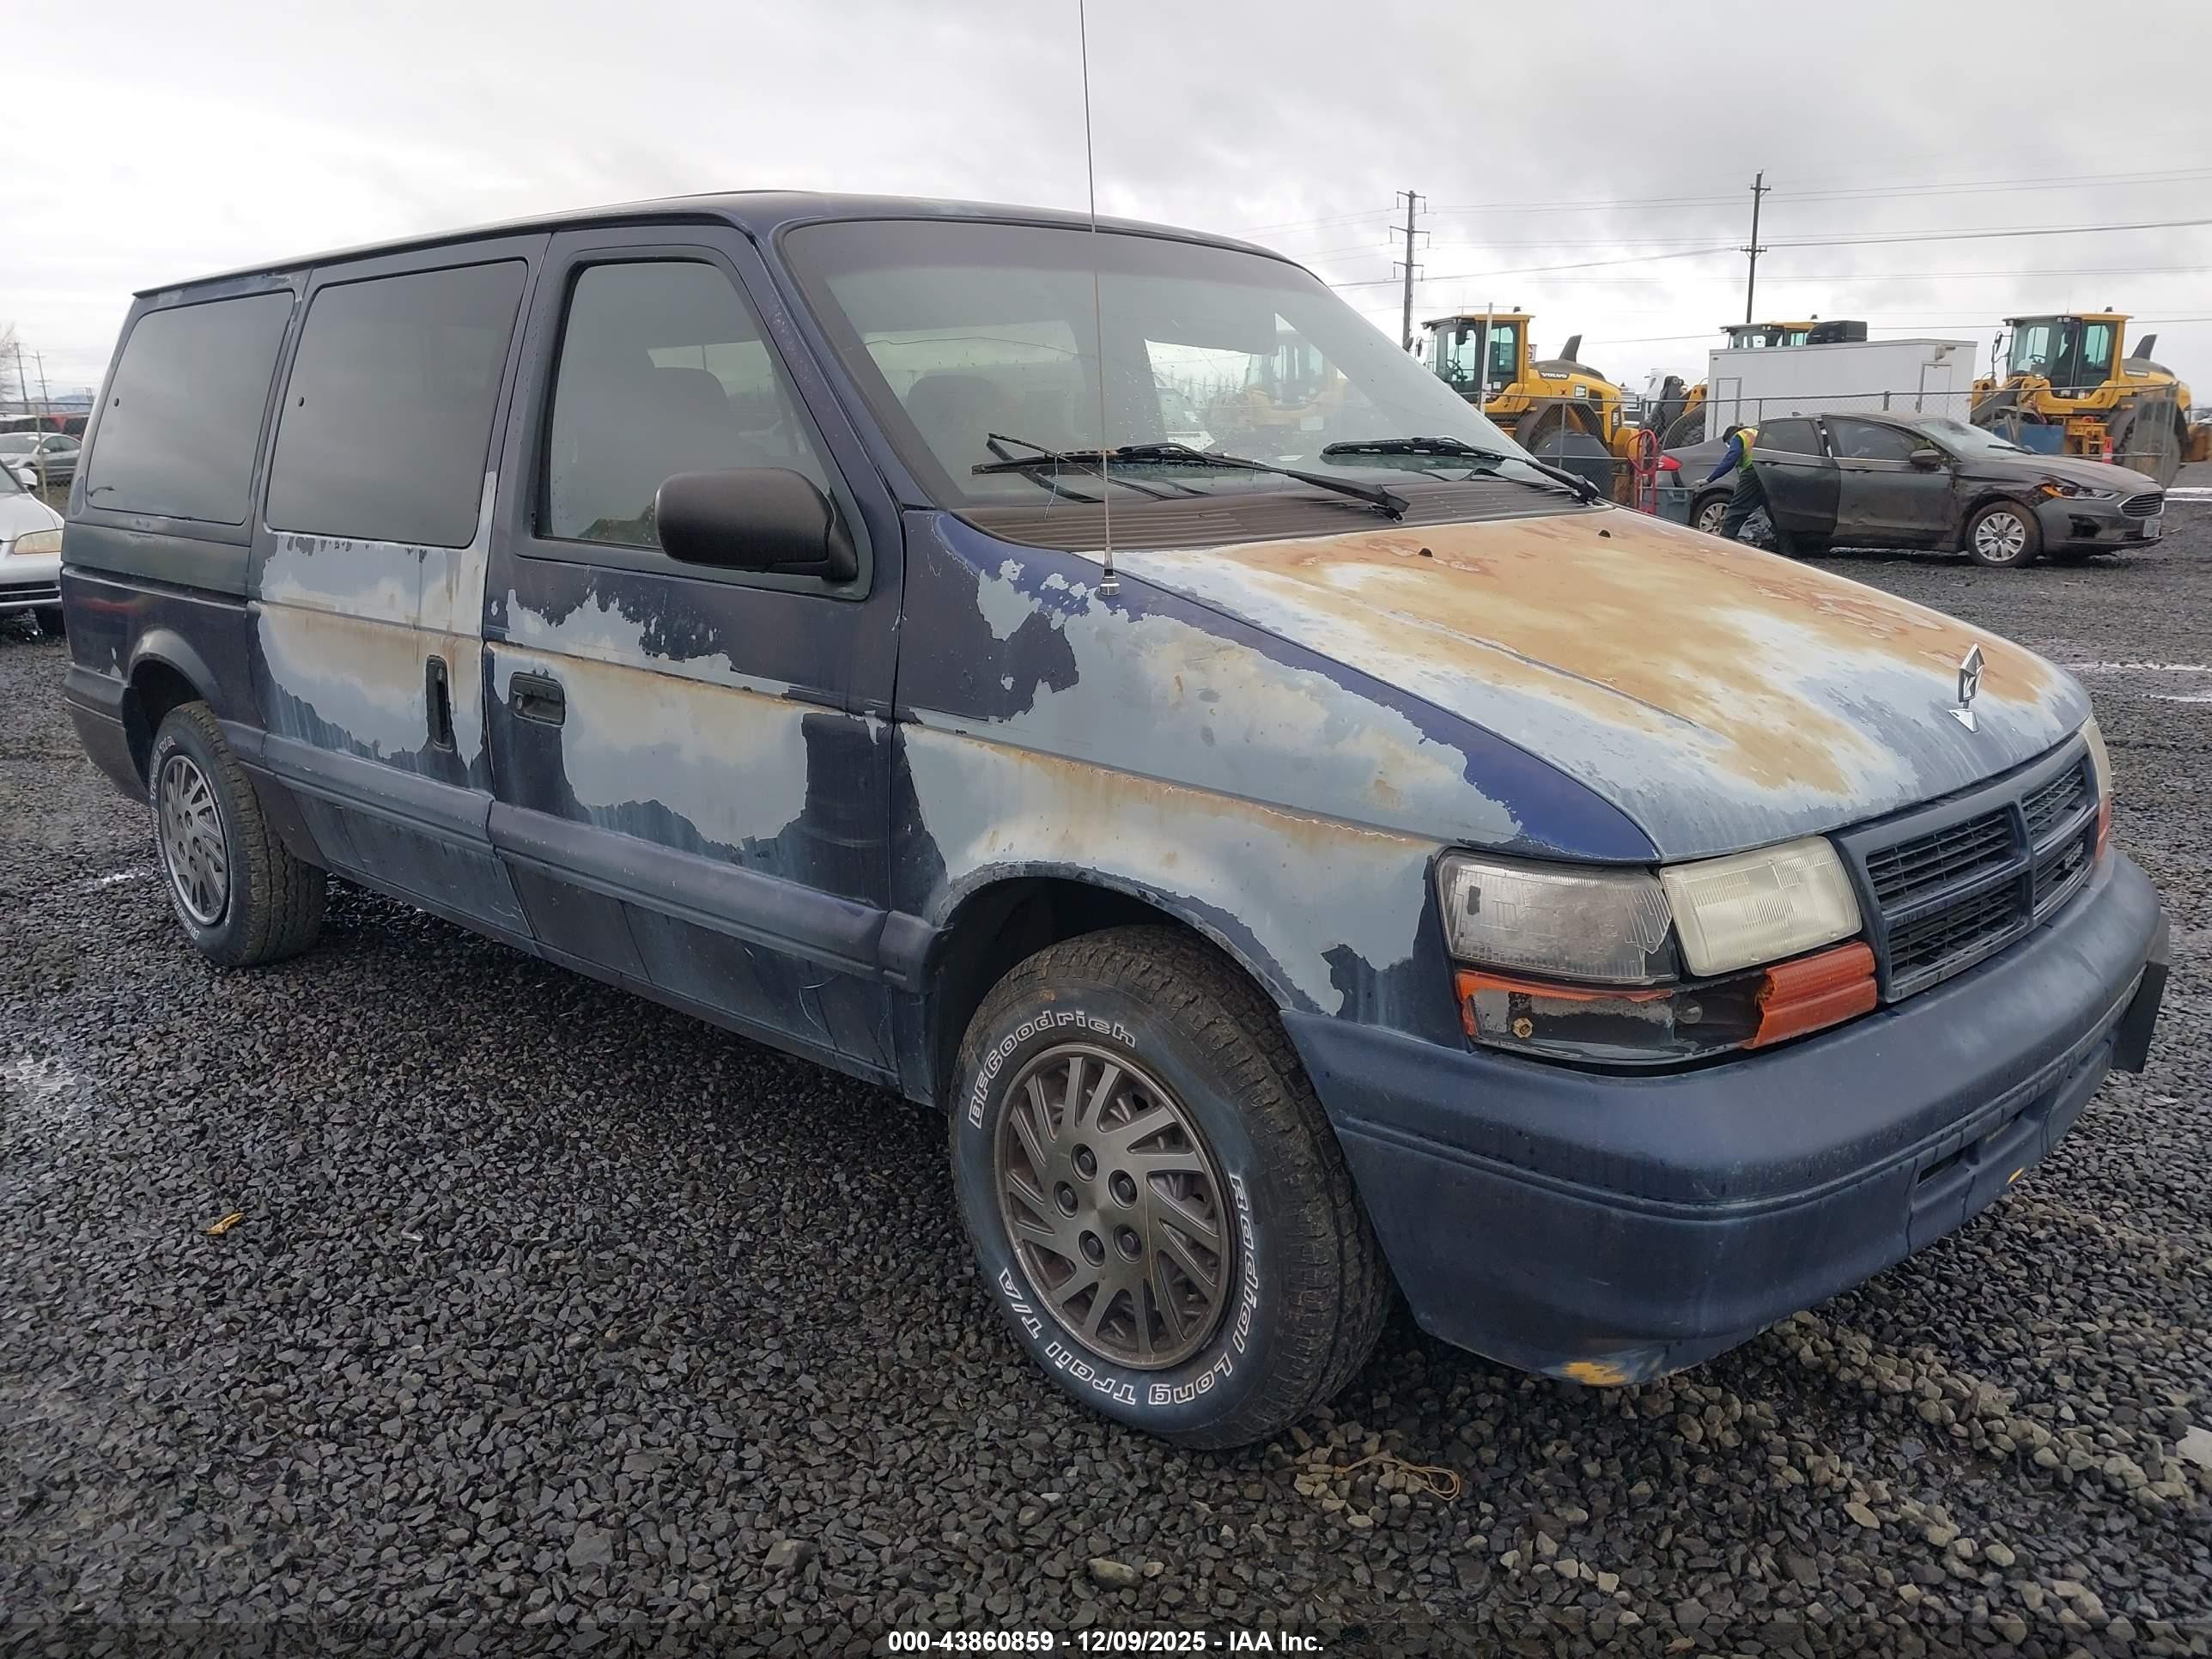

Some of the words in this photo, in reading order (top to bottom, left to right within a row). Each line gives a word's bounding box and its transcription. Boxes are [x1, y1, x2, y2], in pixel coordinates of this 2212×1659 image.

[968, 1010, 1136, 1130] BFGoodrich
[1228, 1172, 1259, 1354] Radial
[998, 1267, 1043, 1340] T/A
[1044, 1340, 1137, 1406] Trail
[1148, 1352, 1234, 1407] Long
